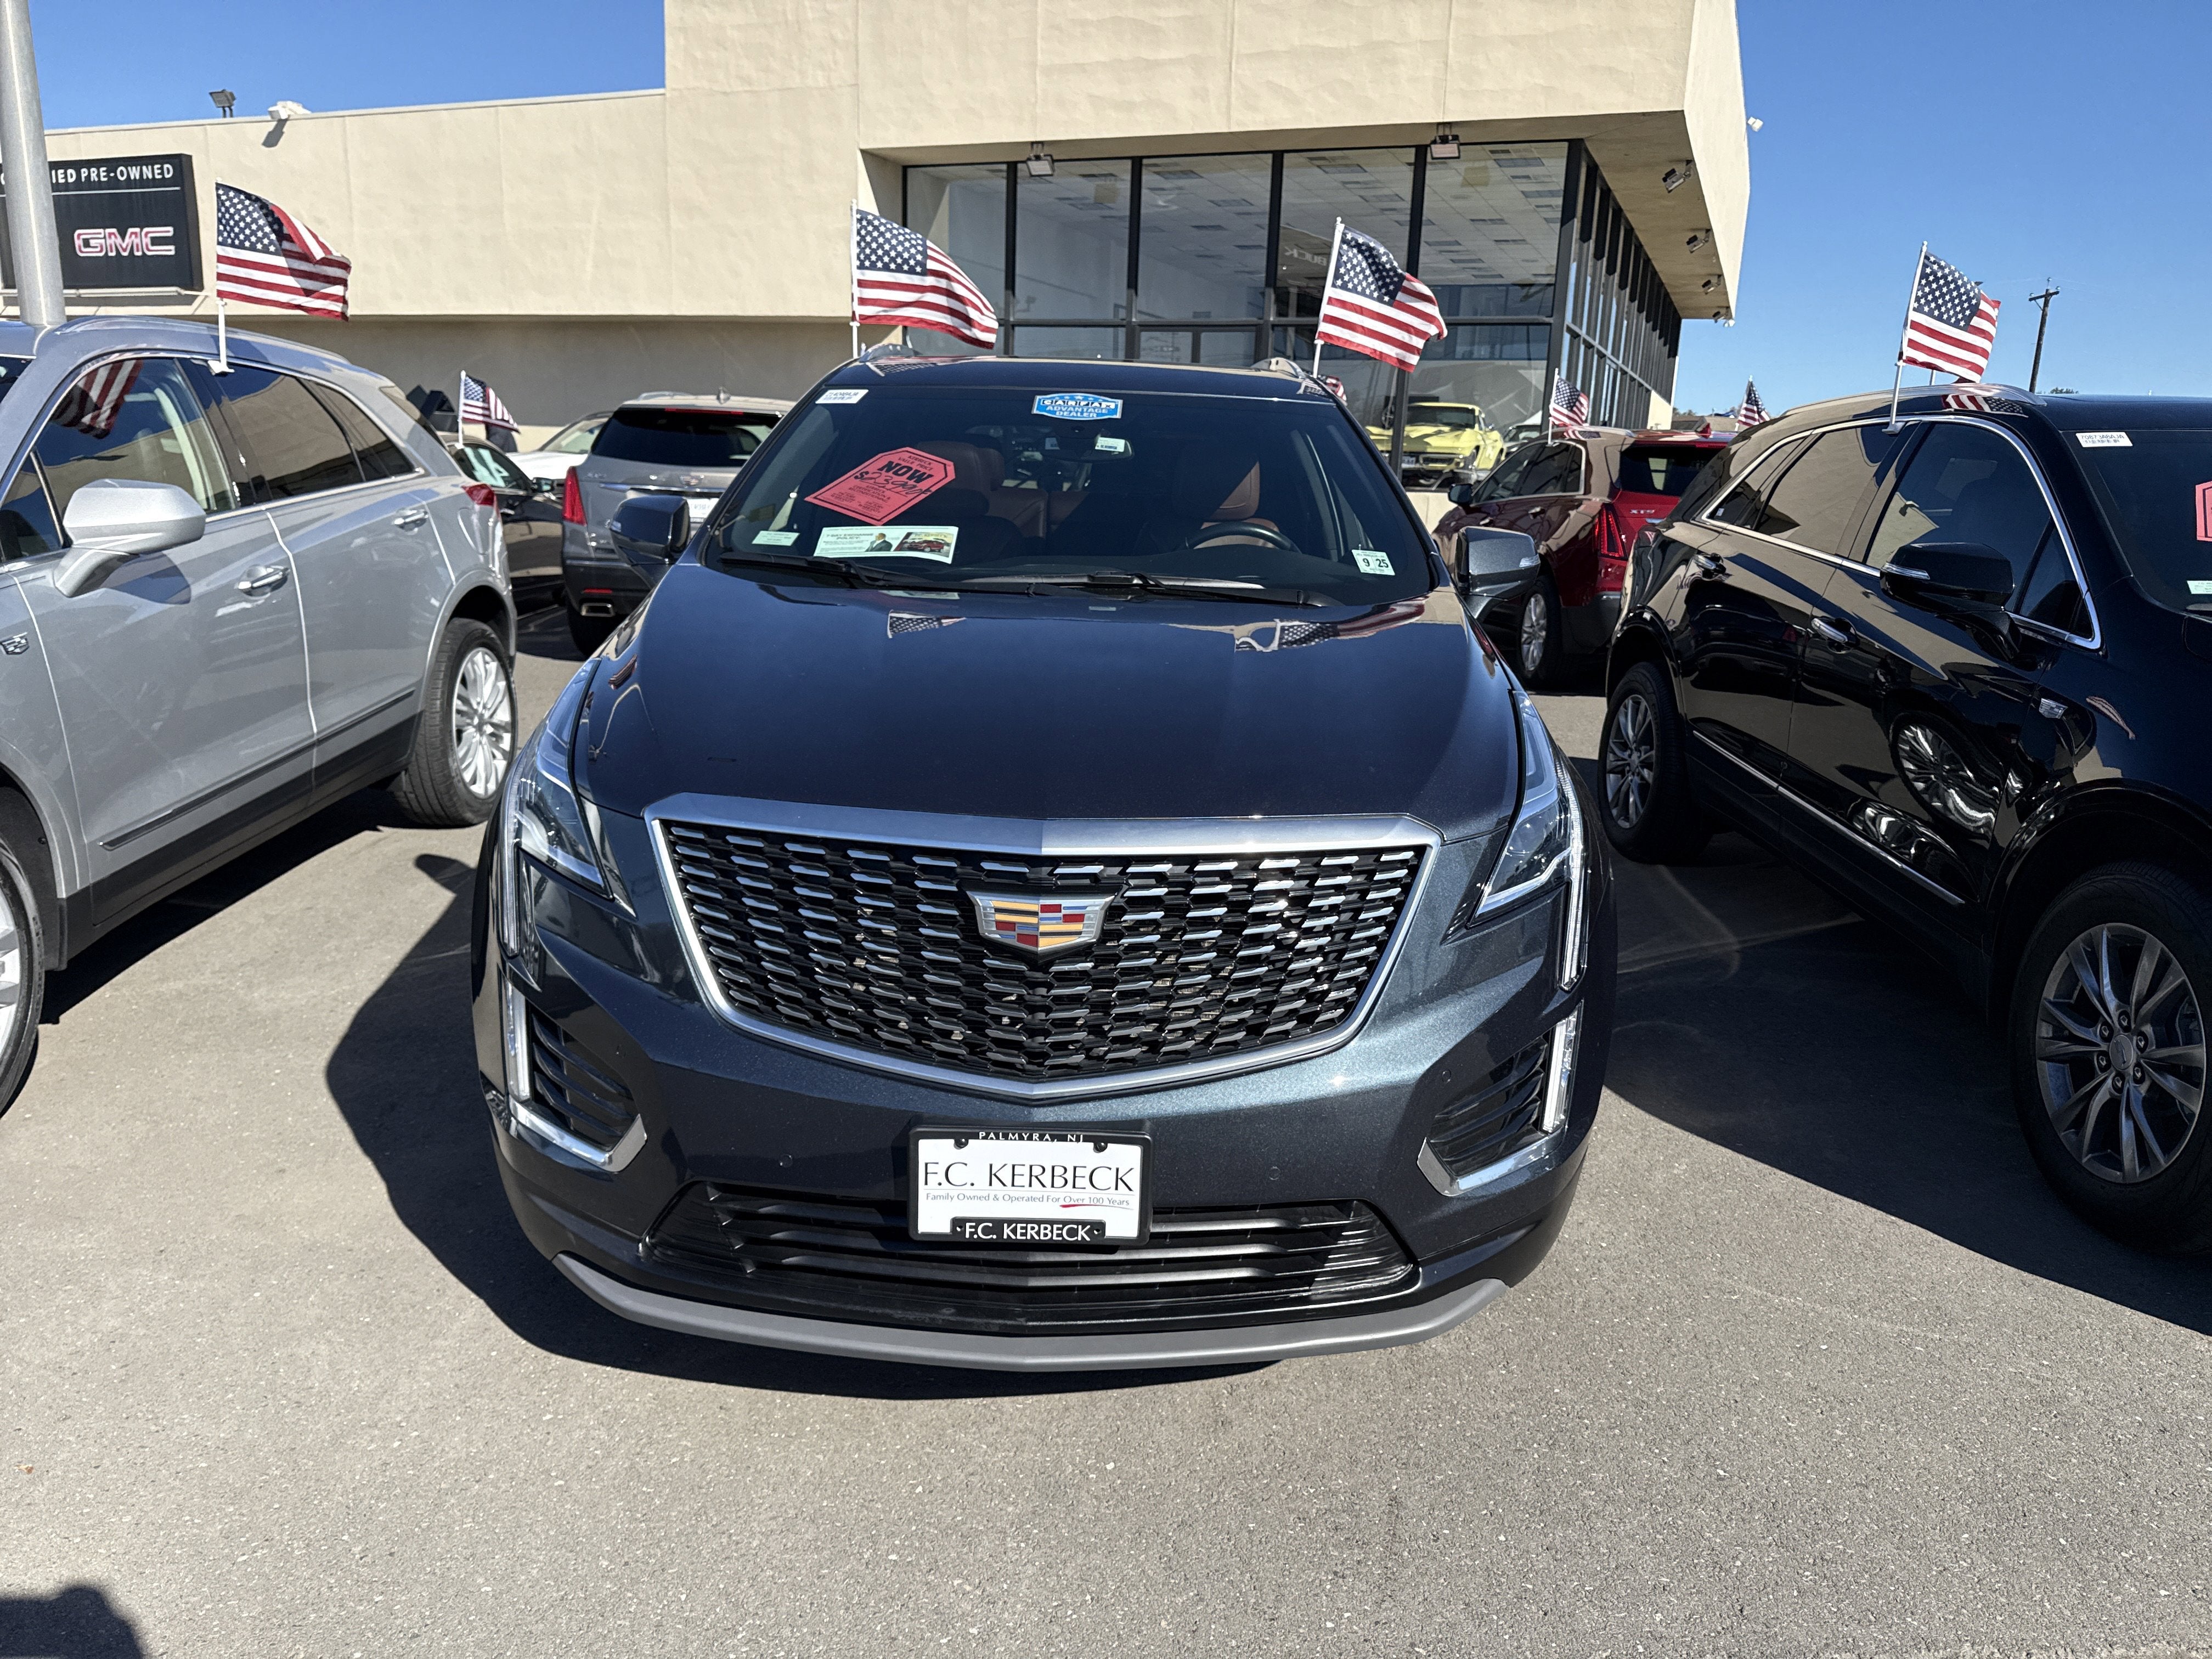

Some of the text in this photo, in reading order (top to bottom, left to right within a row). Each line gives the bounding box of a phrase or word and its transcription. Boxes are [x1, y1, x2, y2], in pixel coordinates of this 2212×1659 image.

[81, 163, 173, 182] PRE-OWNED
[74, 226, 176, 257] GMC
[1042, 399, 1115, 409] CARFAX
[1046, 405, 1108, 414] ADVANTAGE
[877, 460, 934, 484] NOW
[916, 462, 934, 471] PRICE
[1362, 558, 1389, 568] 9 25
[979, 1131, 1084, 1143] PALMYRA, NJ
[924, 1161, 1135, 1192] F.C. KERBECK
[926, 1193, 955, 1203] Family
[957, 1193, 990, 1201] Owned
[1002, 1193, 1044, 1203] Operated
[1046, 1195, 1060, 1203] For
[1063, 1195, 1085, 1204] Over
[1088, 1196, 1104, 1204] 100
[1106, 1197, 1130, 1206] Years
[964, 1222, 1091, 1241] F.C. KERBECK
